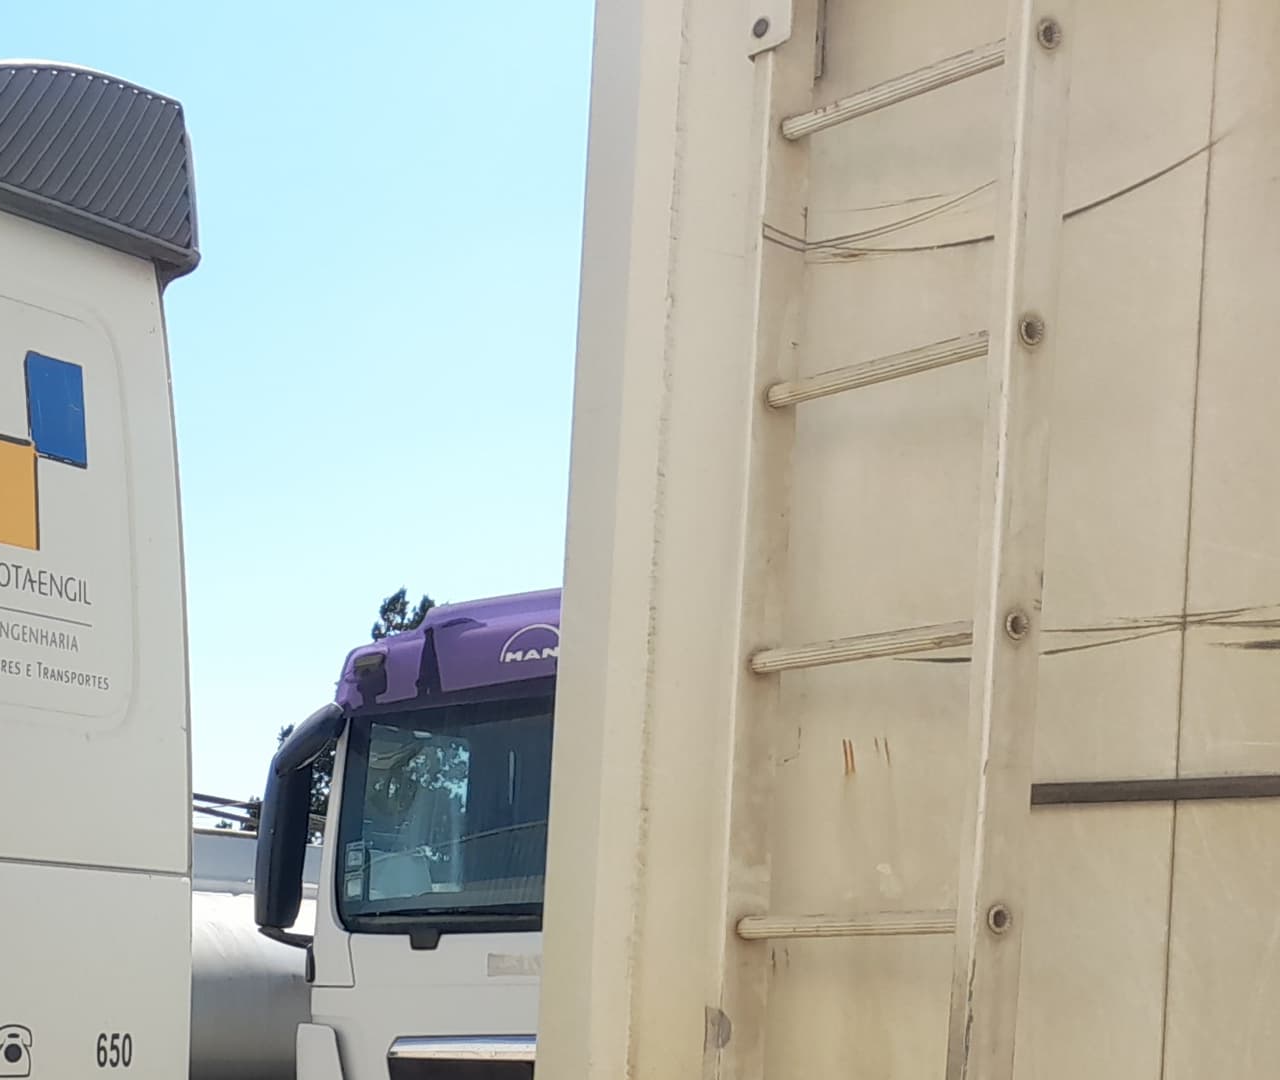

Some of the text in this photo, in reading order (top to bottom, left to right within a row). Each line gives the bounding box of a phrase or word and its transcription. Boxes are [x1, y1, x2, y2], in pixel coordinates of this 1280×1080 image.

[504, 646, 559, 663] MAN
[25, 663, 32, 678] E
[37, 660, 110, 691] TRANSPORTES
[96, 1032, 133, 1068] 650
